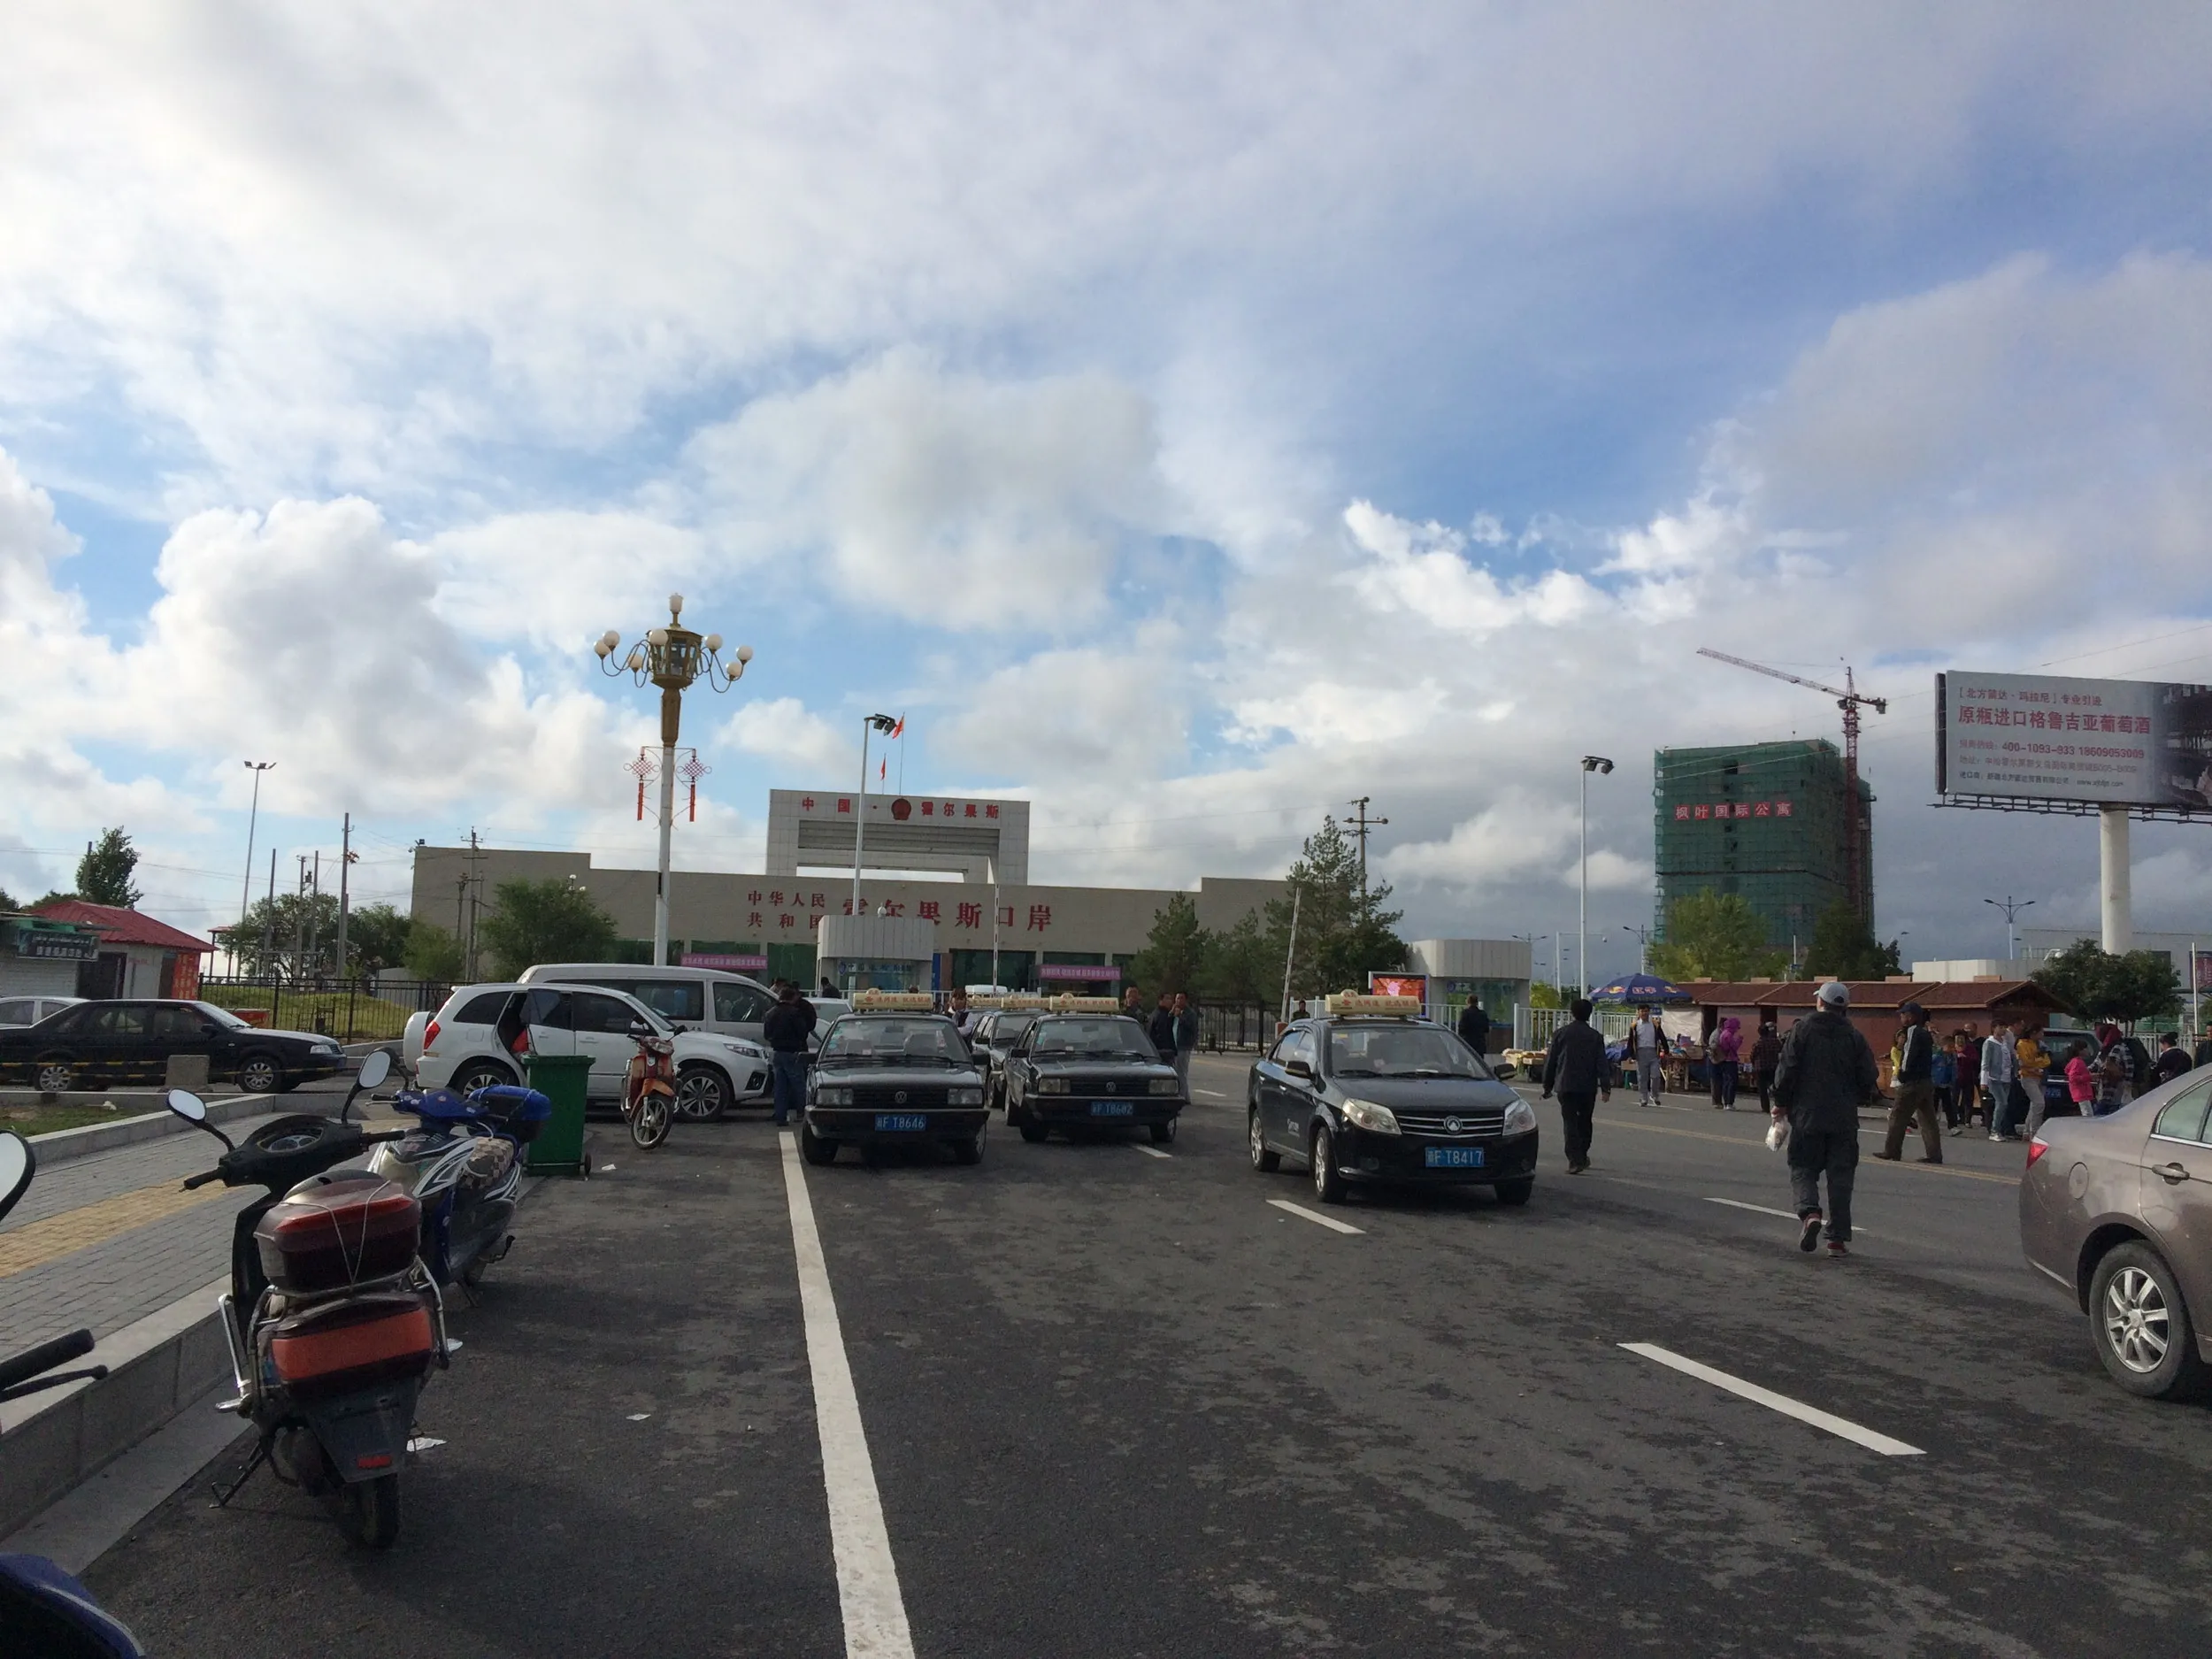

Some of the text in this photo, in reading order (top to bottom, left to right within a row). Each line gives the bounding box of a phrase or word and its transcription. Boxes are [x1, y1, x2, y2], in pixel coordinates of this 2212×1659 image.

[1958, 705, 2152, 734] 原瓶进口格鲁吉亚葡萄酒
[1676, 803, 1792, 819] 枫叶国际公寓
[748, 890, 825, 908] 中华人民
[1446, 1150, 1482, 1164] T8417
